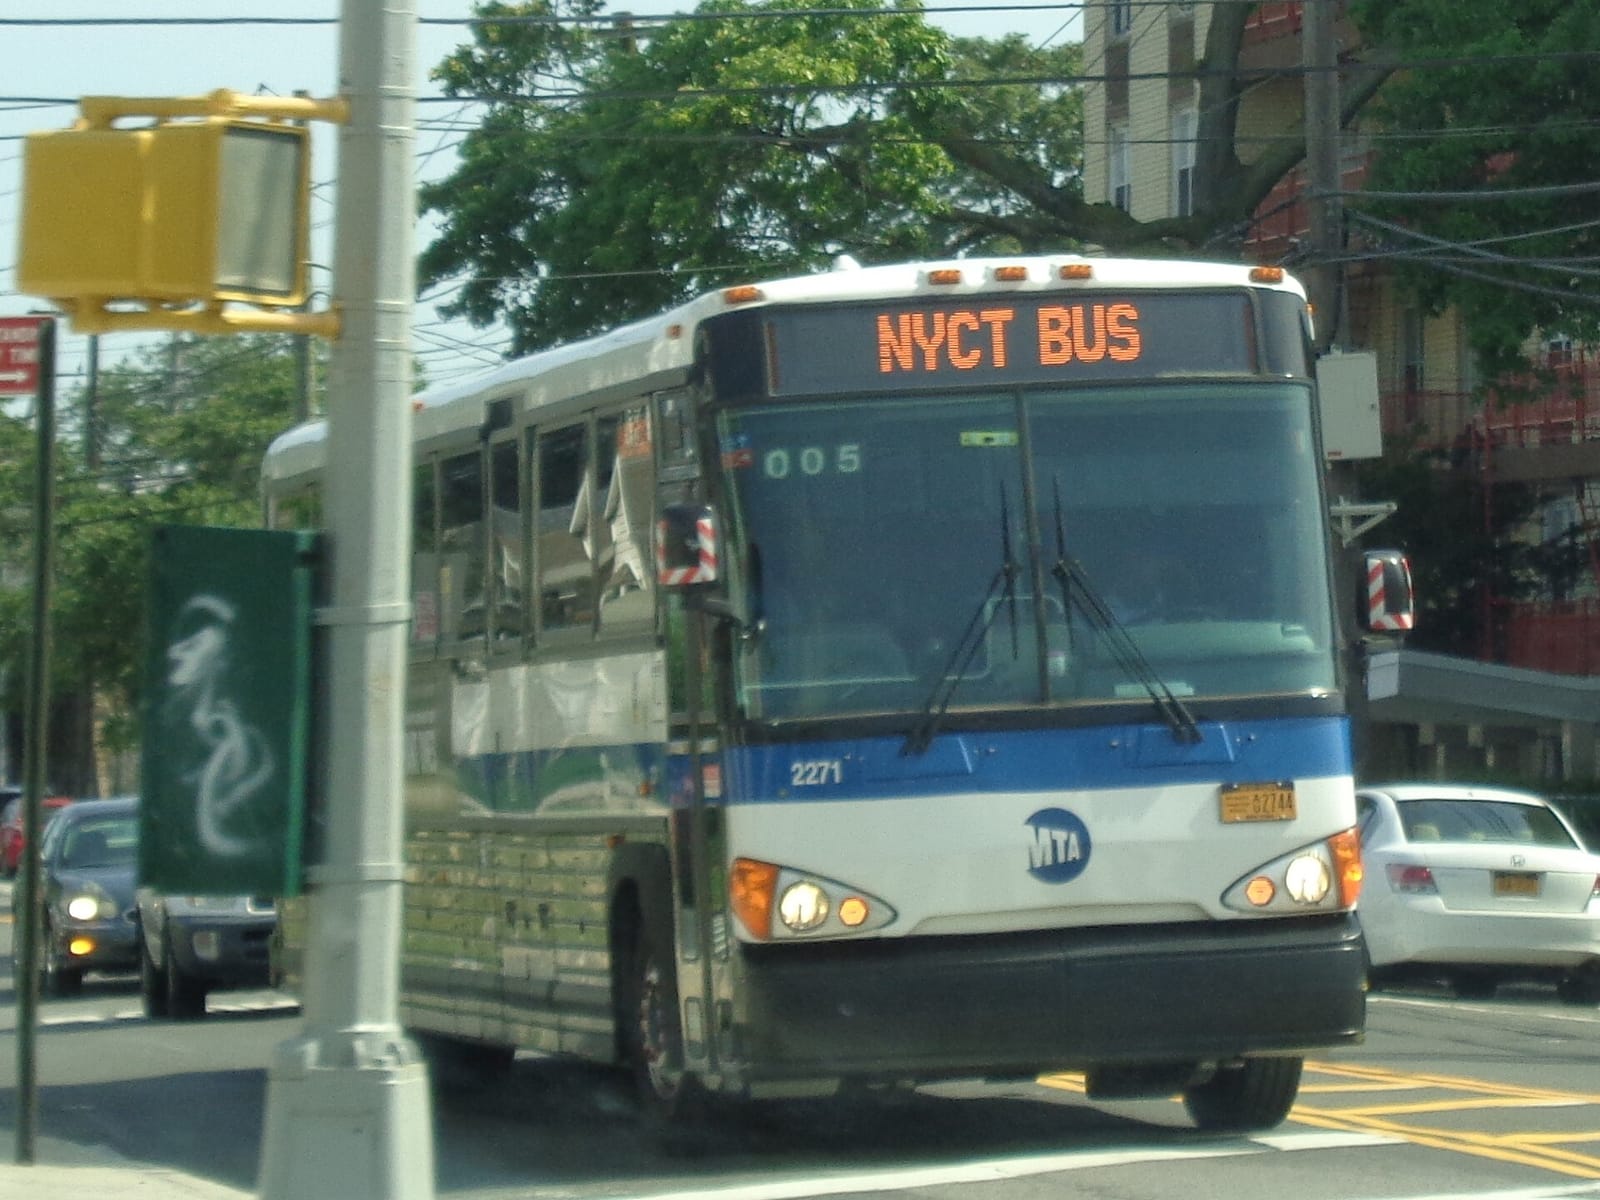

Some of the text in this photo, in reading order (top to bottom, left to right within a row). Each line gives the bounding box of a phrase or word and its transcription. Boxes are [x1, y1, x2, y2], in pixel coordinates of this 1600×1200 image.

[877, 303, 1141, 372] NYCT BUS
[790, 760, 841, 786] 2271
[1024, 824, 1082, 869] MTA
